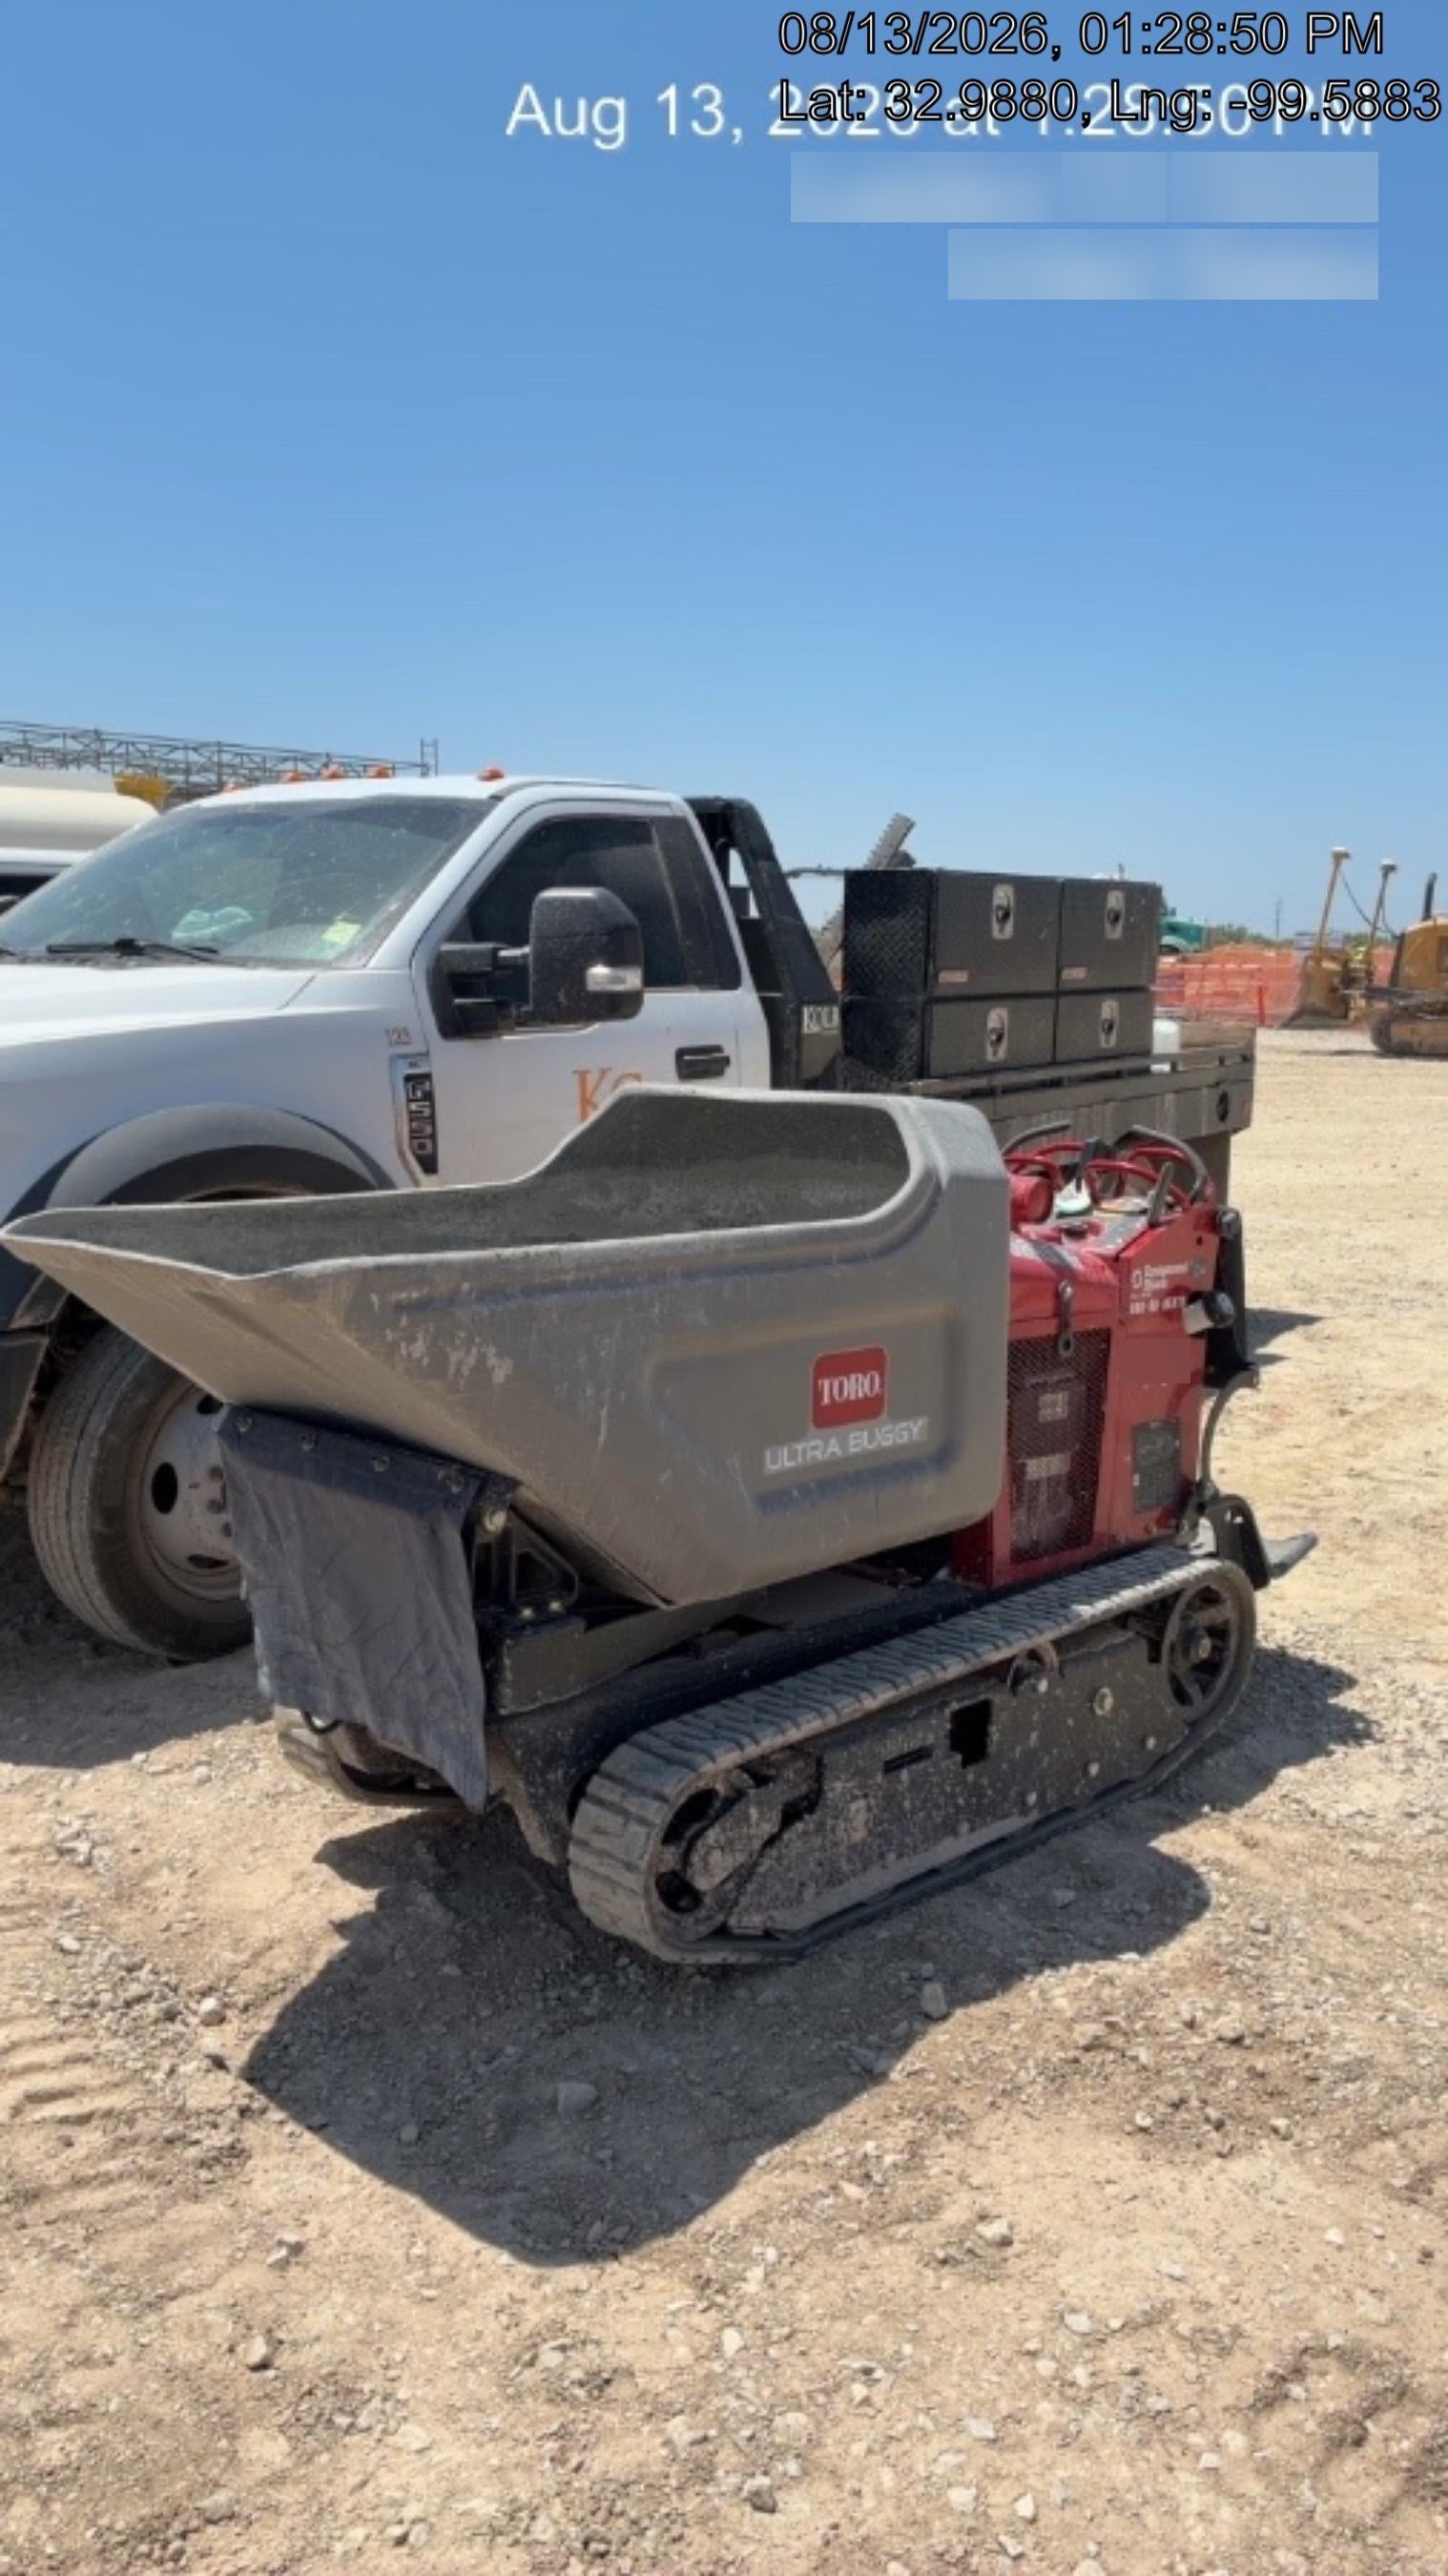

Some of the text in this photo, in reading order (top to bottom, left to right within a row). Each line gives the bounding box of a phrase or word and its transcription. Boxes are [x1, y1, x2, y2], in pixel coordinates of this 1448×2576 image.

[817, 1370, 880, 1407] TORO
[765, 1417, 925, 1470] ULTRA BUGGY
